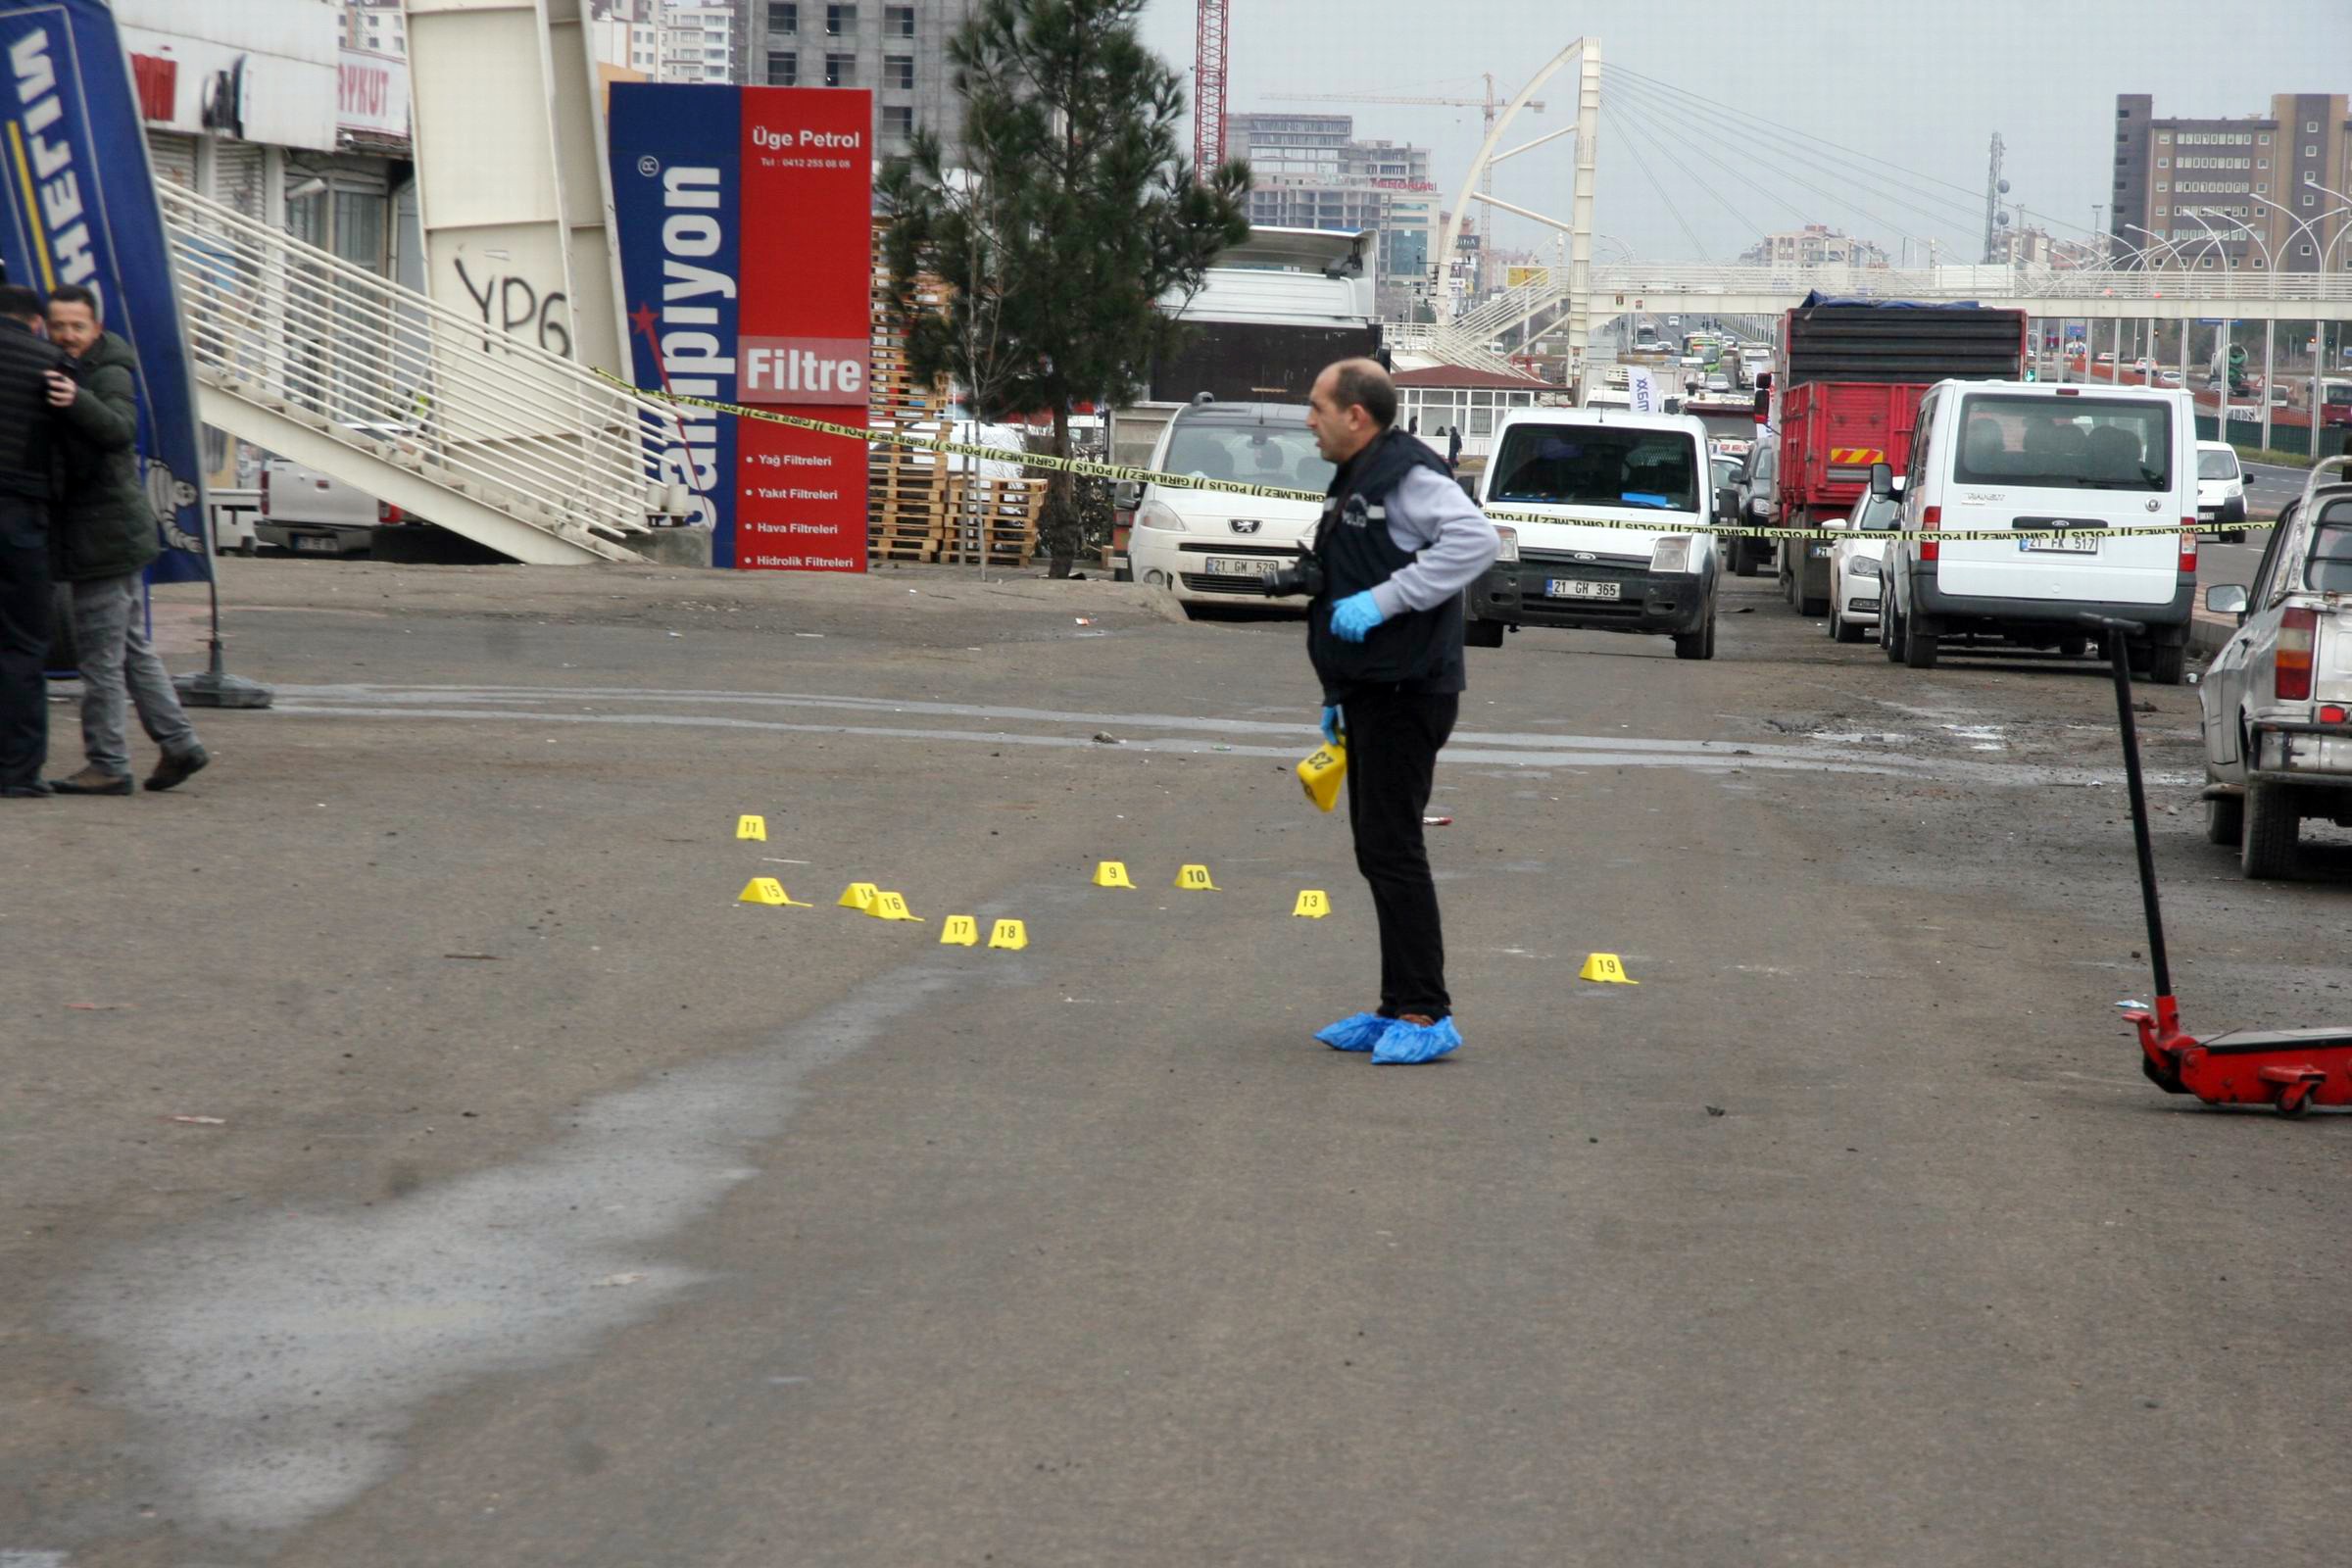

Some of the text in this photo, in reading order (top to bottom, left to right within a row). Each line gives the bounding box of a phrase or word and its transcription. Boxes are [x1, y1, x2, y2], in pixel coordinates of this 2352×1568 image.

[753, 125, 860, 150] Üge Petrol
[761, 158, 774, 167] Tel
[747, 348, 861, 392] Filtre
[759, 455, 832, 467] Yağ Filtreleri
[790, 489, 838, 500] Filtreleri
[758, 522, 838, 534] Hava Filtreleri
[757, 556, 854, 567] Hidrolik Filtreleri
[1215, 560, 1226, 571] 21
[1554, 581, 1616, 596] 21 GH 365
[745, 821, 757, 833] 11
[1108, 866, 1117, 879] 9
[1187, 869, 1205, 883] 10
[763, 885, 779, 898] 15
[883, 898, 901, 910] 16
[1302, 895, 1318, 907] 13
[953, 921, 968, 934] 17
[1001, 925, 1016, 939] 18
[1597, 959, 1616, 973] 19
